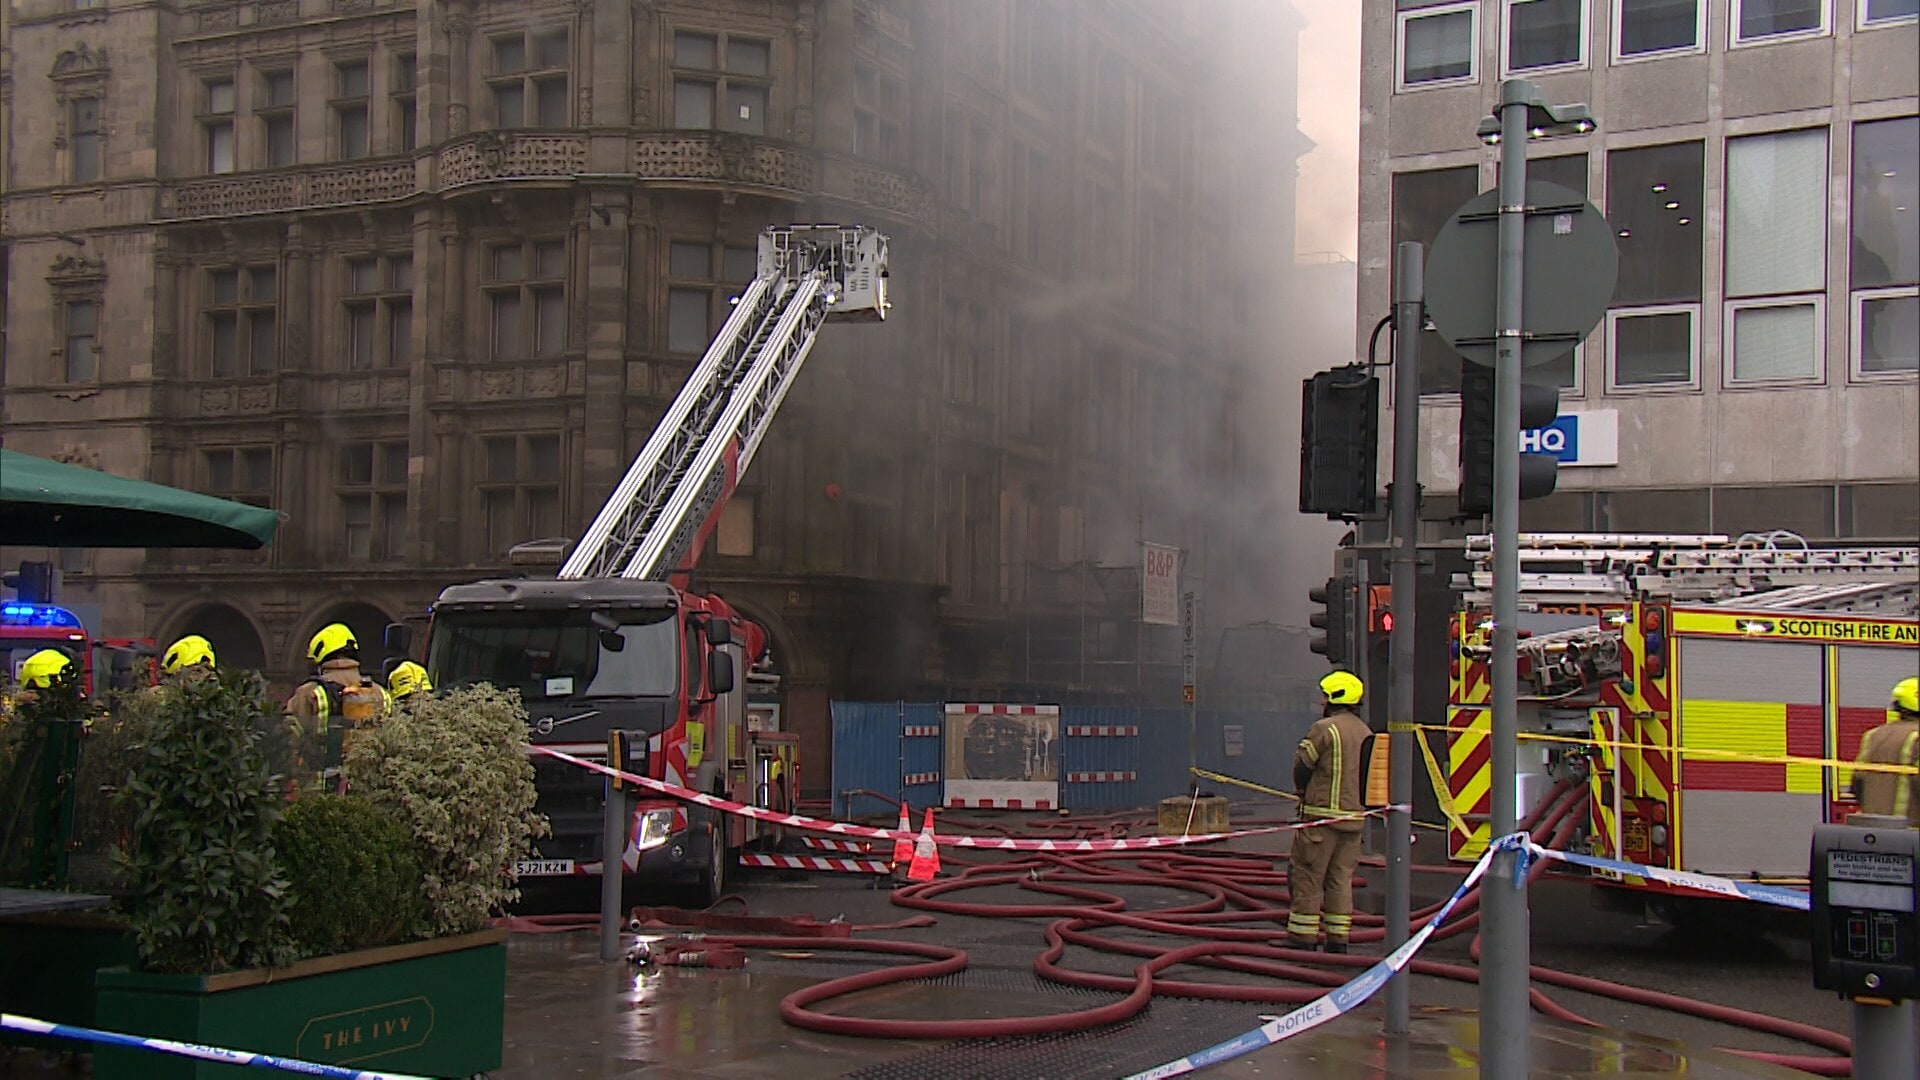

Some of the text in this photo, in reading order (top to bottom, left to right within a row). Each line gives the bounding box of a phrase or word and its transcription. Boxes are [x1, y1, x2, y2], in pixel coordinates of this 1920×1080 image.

[1519, 428, 1565, 453] HQ
[1146, 550, 1174, 577] B&P
[1779, 619, 1854, 638] SCOTTISH
[1859, 624, 1890, 639] FIRE
[323, 1015, 412, 1051] THE IVY
